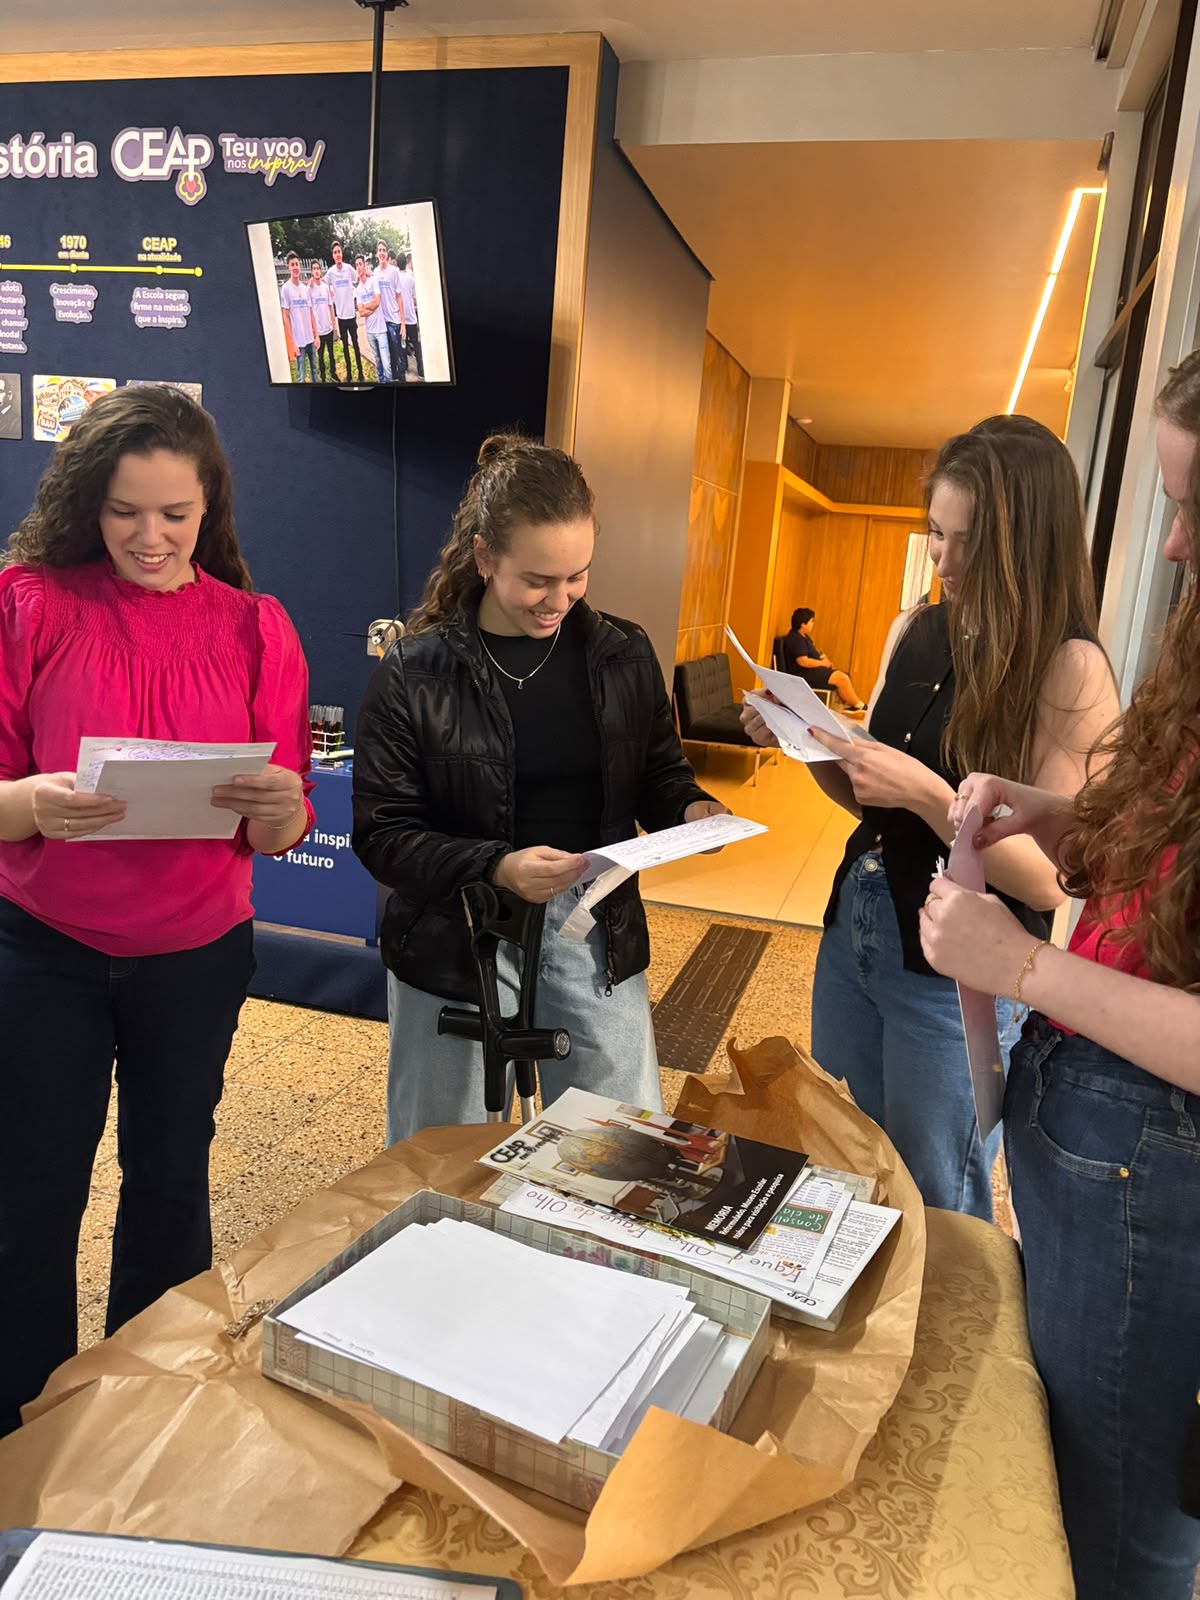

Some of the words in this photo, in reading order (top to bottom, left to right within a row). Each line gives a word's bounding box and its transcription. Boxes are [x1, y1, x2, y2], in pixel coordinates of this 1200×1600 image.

[222, 137, 258, 157] Teu
[264, 141, 301, 157] voo
[114, 131, 211, 181] CEAP
[227, 159, 247, 169] nos
[248, 144, 322, 182] inspira!
[60, 235, 87, 249] 1970
[142, 237, 177, 251] CEAP
[52, 286, 96, 297] Crescimento,
[142, 291, 164, 299] Escola
[56, 298, 86, 308] Inovação
[133, 302, 152, 311] firme
[163, 303, 188, 312] missão
[1, 318, 26, 327] chamar
[58, 311, 90, 320] Evolução.
[137, 316, 151, 325] que
[158, 316, 184, 325] inspira.
[314, 829, 352, 849] inspi
[286, 849, 334, 869] futuro
[490, 1140, 525, 1163] CEAP
[526, 1190, 568, 1213] Olho
[719, 1208, 747, 1236] Reformulado,
[741, 1193, 757, 1209] Museu
[751, 1177, 768, 1194] Escolar
[743, 1216, 756, 1228] para
[751, 1198, 769, 1217] visitação
[767, 1173, 784, 1195] pesquisa
[573, 1206, 596, 1219] de
[704, 1205, 734, 1232] MEMÓRIA
[809, 1213, 824, 1223] de
[787, 1291, 817, 1307] CEAP
